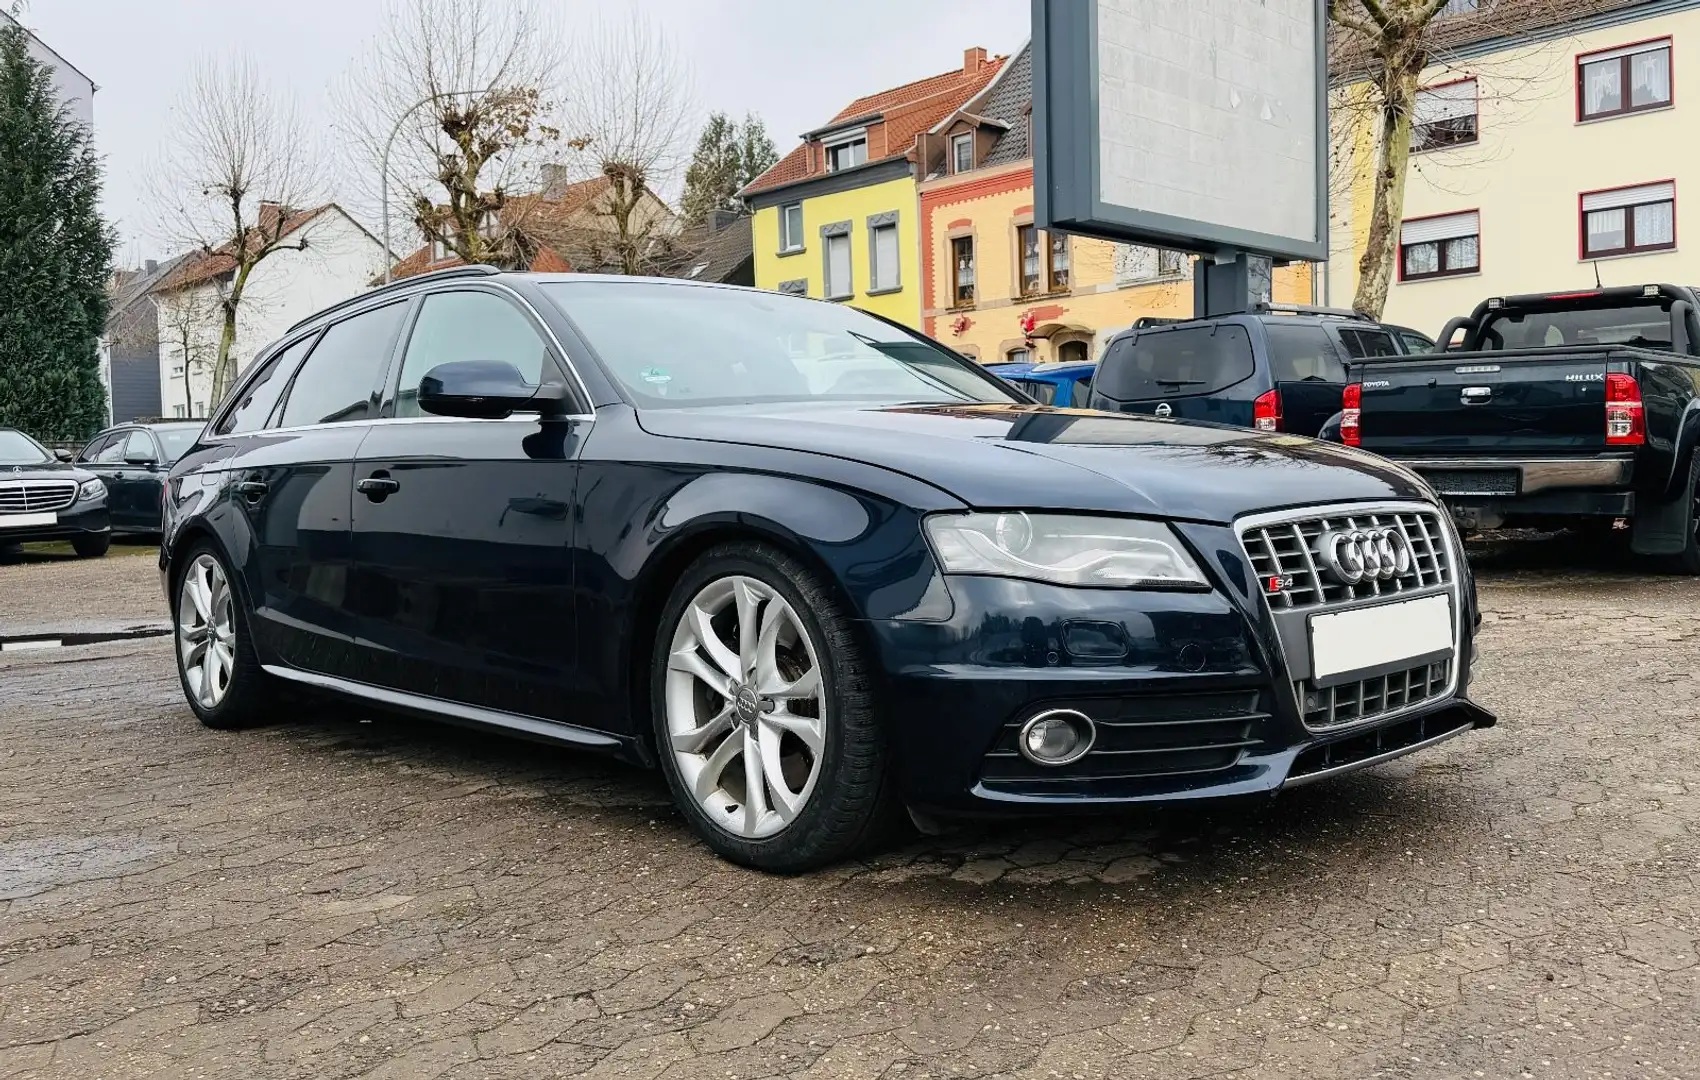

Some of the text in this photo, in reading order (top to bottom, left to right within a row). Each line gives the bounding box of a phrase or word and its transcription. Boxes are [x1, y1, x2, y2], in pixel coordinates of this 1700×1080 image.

[1565, 373, 1604, 382] HILUX
[1363, 380, 1390, 388] TOYOTA
[1275, 578, 1294, 588] S4
